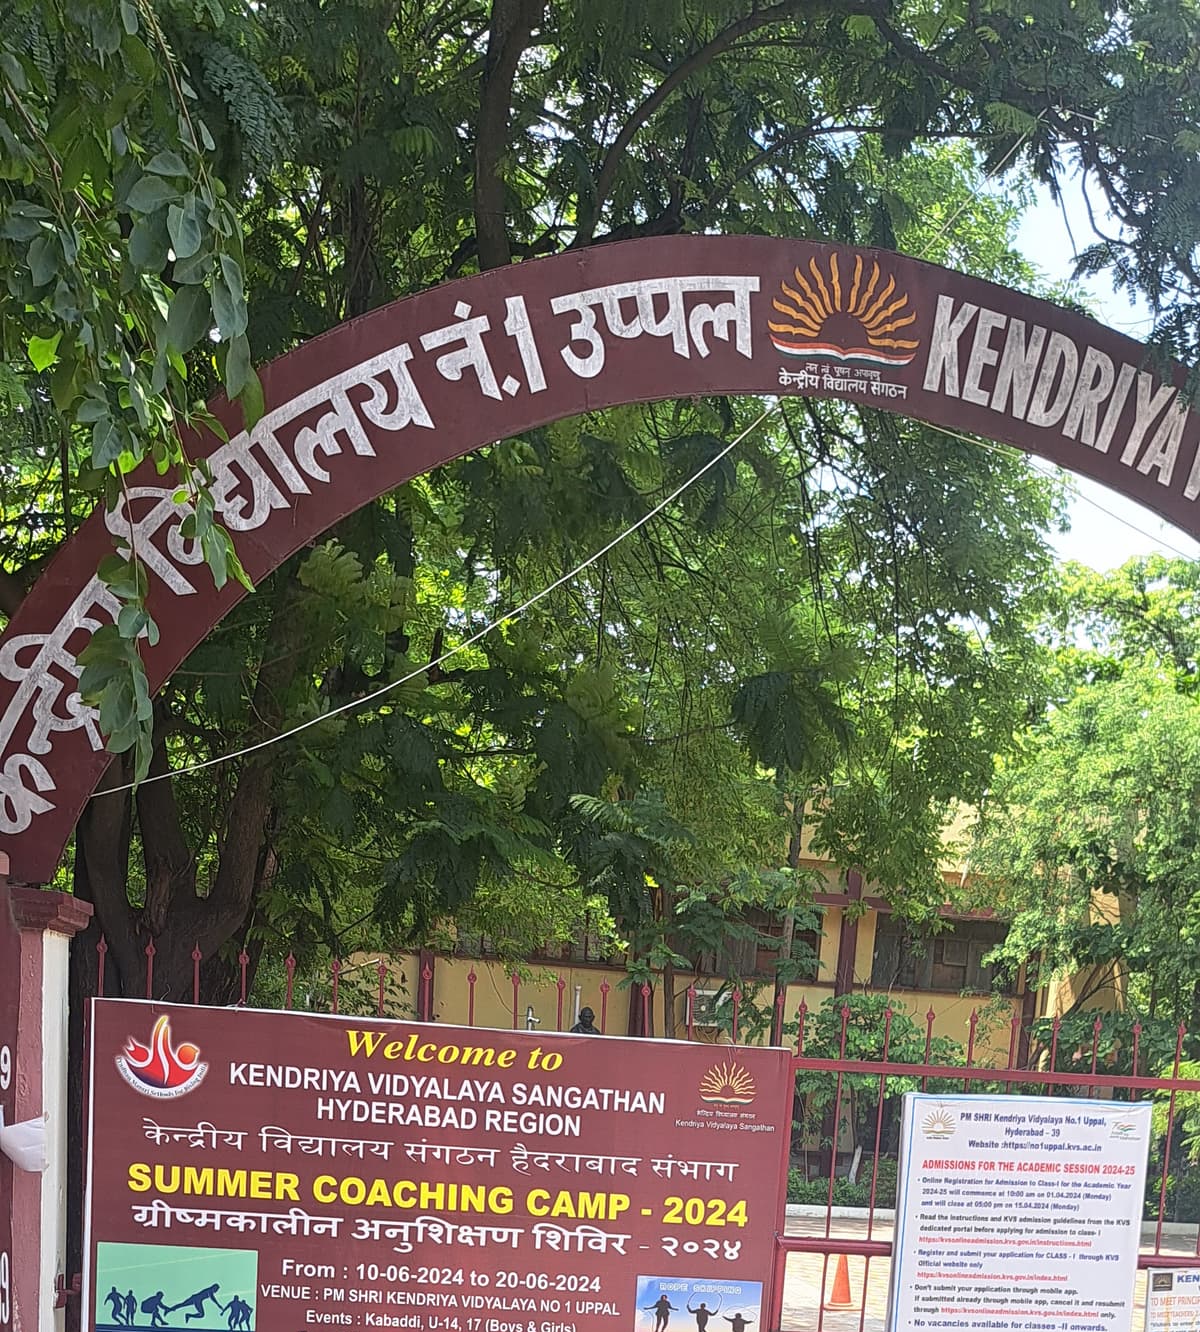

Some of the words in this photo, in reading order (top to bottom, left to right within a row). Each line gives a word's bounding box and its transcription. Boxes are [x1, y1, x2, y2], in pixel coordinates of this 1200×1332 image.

[551, 275, 761, 379] उप्पल
[822, 373, 868, 394] विद्यालय
[922, 294, 1191, 487] KENDRIYA
[346, 1030, 517, 1068] Welcome
[527, 1046, 563, 1071] to
[229, 1062, 361, 1094] KENDRIYA
[368, 1072, 505, 1104] VIDYALAYA
[512, 1082, 665, 1114] SANGATHAN
[317, 1097, 477, 1131] HYDERABAD
[485, 1108, 581, 1137] REGION
[675, 1119, 705, 1128] Kendriya
[706, 1121, 738, 1131] Vidyalaya
[739, 1123, 775, 1132] Sangathan
[960, 1112, 972, 1121] PM
[973, 1113, 992, 1121] SHRI
[994, 1113, 1026, 1125] Kendriya
[1028, 1114, 1063, 1126] Vidyalaya
[1065, 1115, 1081, 1125] No.1
[1083, 1116, 1107, 1127] Uppal,
[1004, 1127, 1044, 1138] Hyderabad
[1051, 1128, 1061, 1137] 39
[143, 1117, 248, 1151] केन्द्रीय
[258, 1125, 394, 1161] विद्यालय
[404, 1138, 501, 1168] संगठन
[509, 1143, 642, 1176] हैदराबाद
[650, 1154, 739, 1182] संभाग
[968, 1140, 999, 1149] Website
[922, 1160, 976, 1170] ADMISSIONS
[978, 1161, 995, 1171] FOR
[997, 1162, 1014, 1171] THE
[1017, 1162, 1061, 1173] ACADEMIC
[1063, 1163, 1100, 1174] SESSION
[1102, 1164, 1136, 1175] 2024-25
[944, 1177, 983, 1185] Registration
[127, 1163, 300, 1201] SUMMER
[312, 1175, 513, 1215] COACHING
[526, 1188, 631, 1221] CAMP
[662, 1196, 748, 1227] 2024
[1082, 1193, 1112, 1201] (Monday)
[1050, 1203, 1080, 1211] (Monday)
[131, 1199, 344, 1237] ग्रीष्मकालीन
[351, 1215, 525, 1254] अनुशिक्षण
[532, 1222, 632, 1255] शिविर
[661, 1236, 742, 1260] २०२४
[282, 1259, 335, 1279] From
[356, 1263, 464, 1285] 10-06-2024
[470, 1270, 490, 1287] to
[495, 1271, 601, 1293] 20-06-2024
[260, 1284, 311, 1300] VENUE
[323, 1288, 345, 1302] PM
[348, 1289, 383, 1304] SHRI
[386, 1291, 458, 1307] KENDRIYA
[461, 1294, 537, 1312] VIDYALAYA
[540, 1299, 561, 1313] NO
[565, 1301, 571, 1314] 1
[575, 1301, 620, 1316] UPPAL
[1012, 1287, 1038, 1295] through
[306, 1310, 353, 1325] Events
[365, 1312, 424, 1331] Kabaddi,
[428, 1316, 462, 1332] U-14,
[466, 1317, 482, 1331] 17
[914, 1319, 925, 1327] No
[927, 1320, 969, 1328] vacancies
[971, 1320, 1009, 1329] available
[1011, 1321, 1022, 1329] for
[1024, 1322, 1056, 1330] classes
[1070, 1324, 1108, 1332] onwards.
